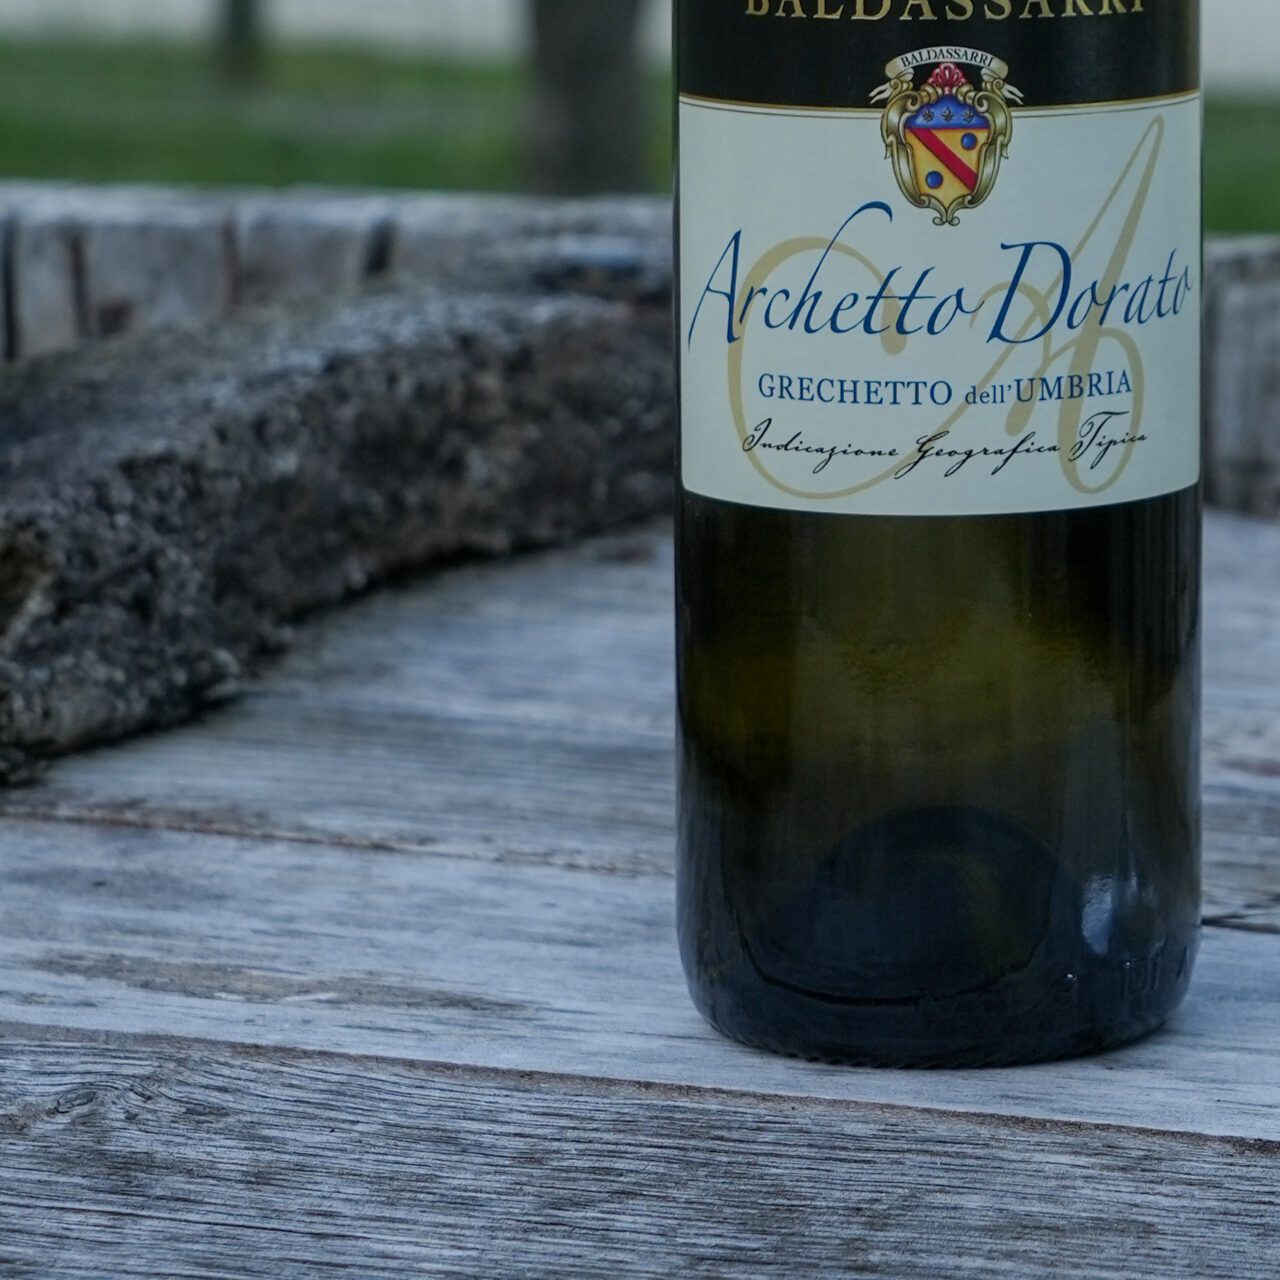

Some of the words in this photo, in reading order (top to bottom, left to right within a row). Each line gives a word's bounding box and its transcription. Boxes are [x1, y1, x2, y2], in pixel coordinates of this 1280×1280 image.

[901, 48, 994, 68] BALDASSARRI
[688, 201, 985, 353] Archetto
[986, 241, 1193, 344] Dorato
[758, 372, 952, 406] GRECHETTO
[964, 369, 1132, 405] dell'UMBRIA
[742, 418, 899, 474] Indicazione
[894, 430, 1061, 479] Geografica
[1068, 410, 1149, 470] Tipica
